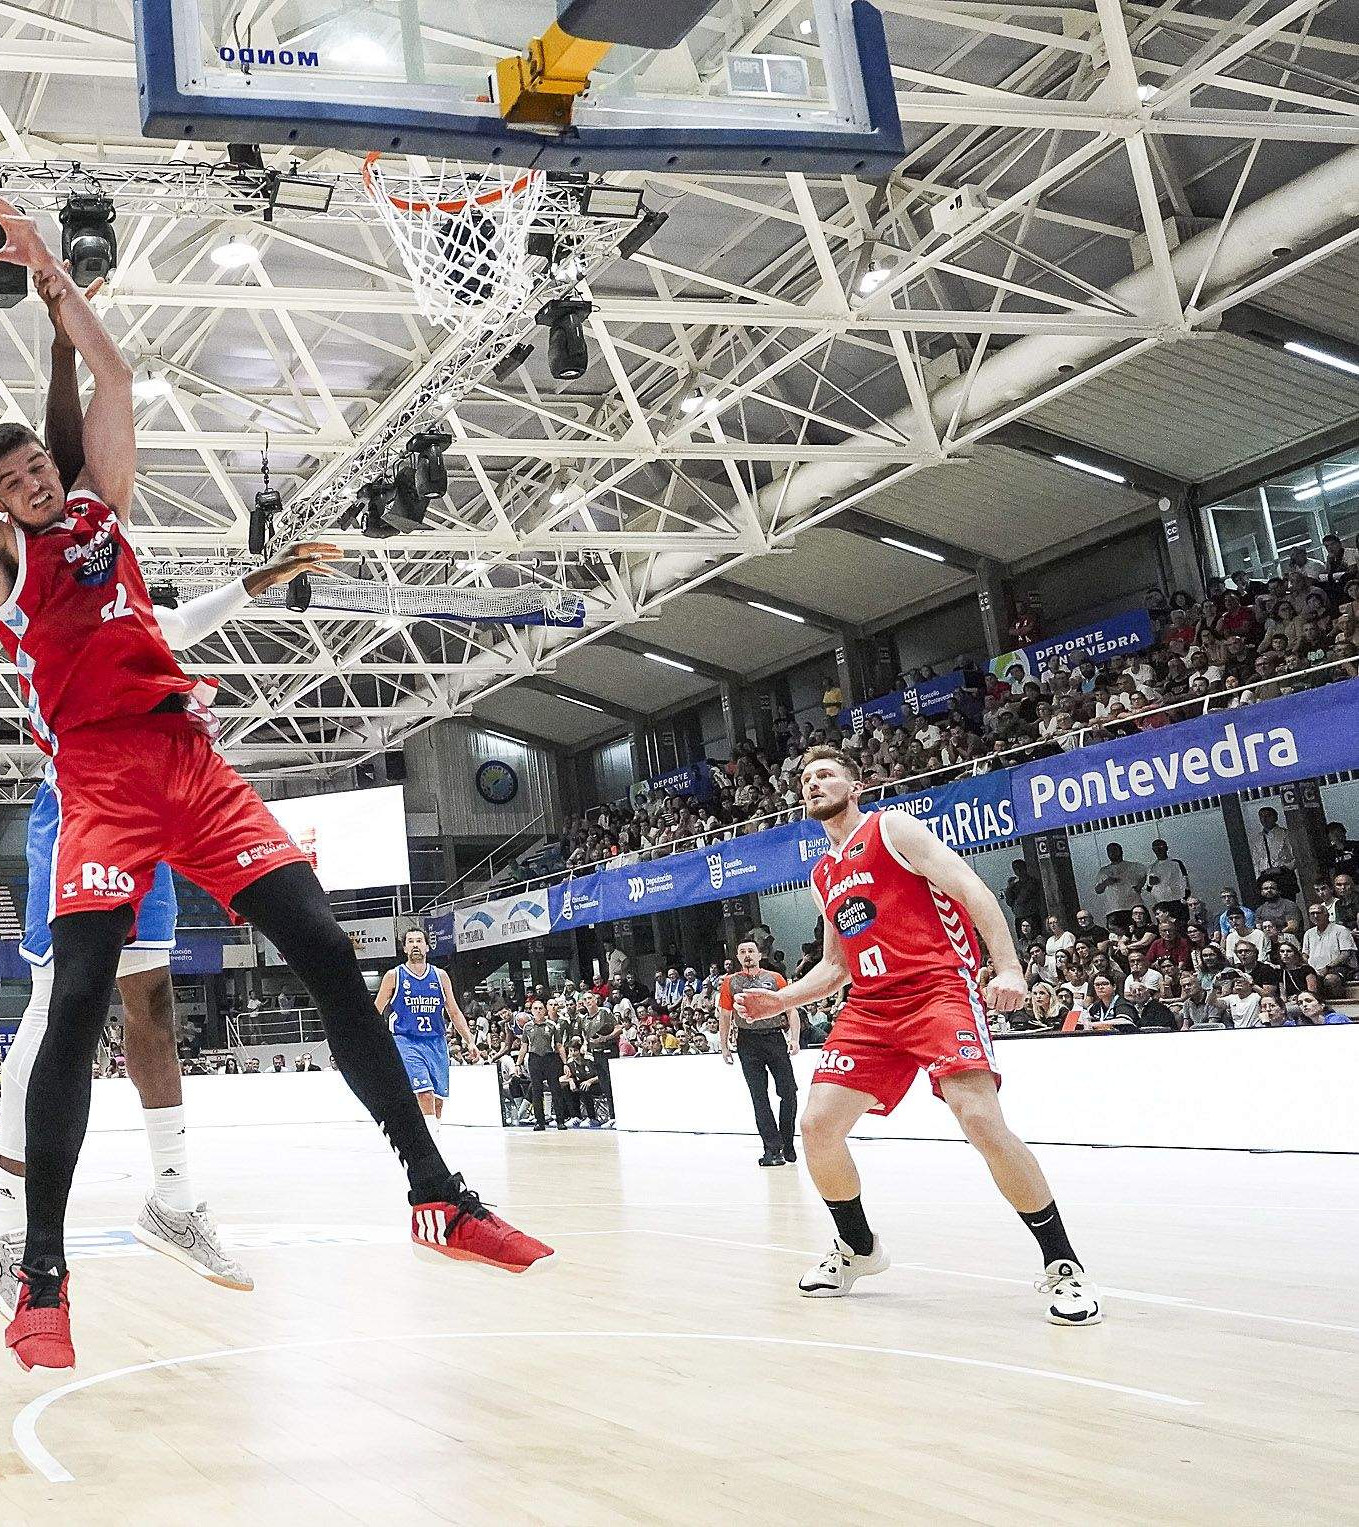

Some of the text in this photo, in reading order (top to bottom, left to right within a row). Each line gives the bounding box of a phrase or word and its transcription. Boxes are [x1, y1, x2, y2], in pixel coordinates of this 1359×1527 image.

[1038, 633, 1140, 672] PNVEDRA
[653, 772, 688, 789] DEPORTE
[1030, 723, 1299, 819] Pontevedra
[807, 837, 829, 848] XUNTA
[838, 902, 865, 922] Estrella
[840, 911, 867, 931] Galicia
[859, 945, 888, 978] 47
[404, 995, 440, 1005] Emirates
[417, 1017, 432, 1031] 23
